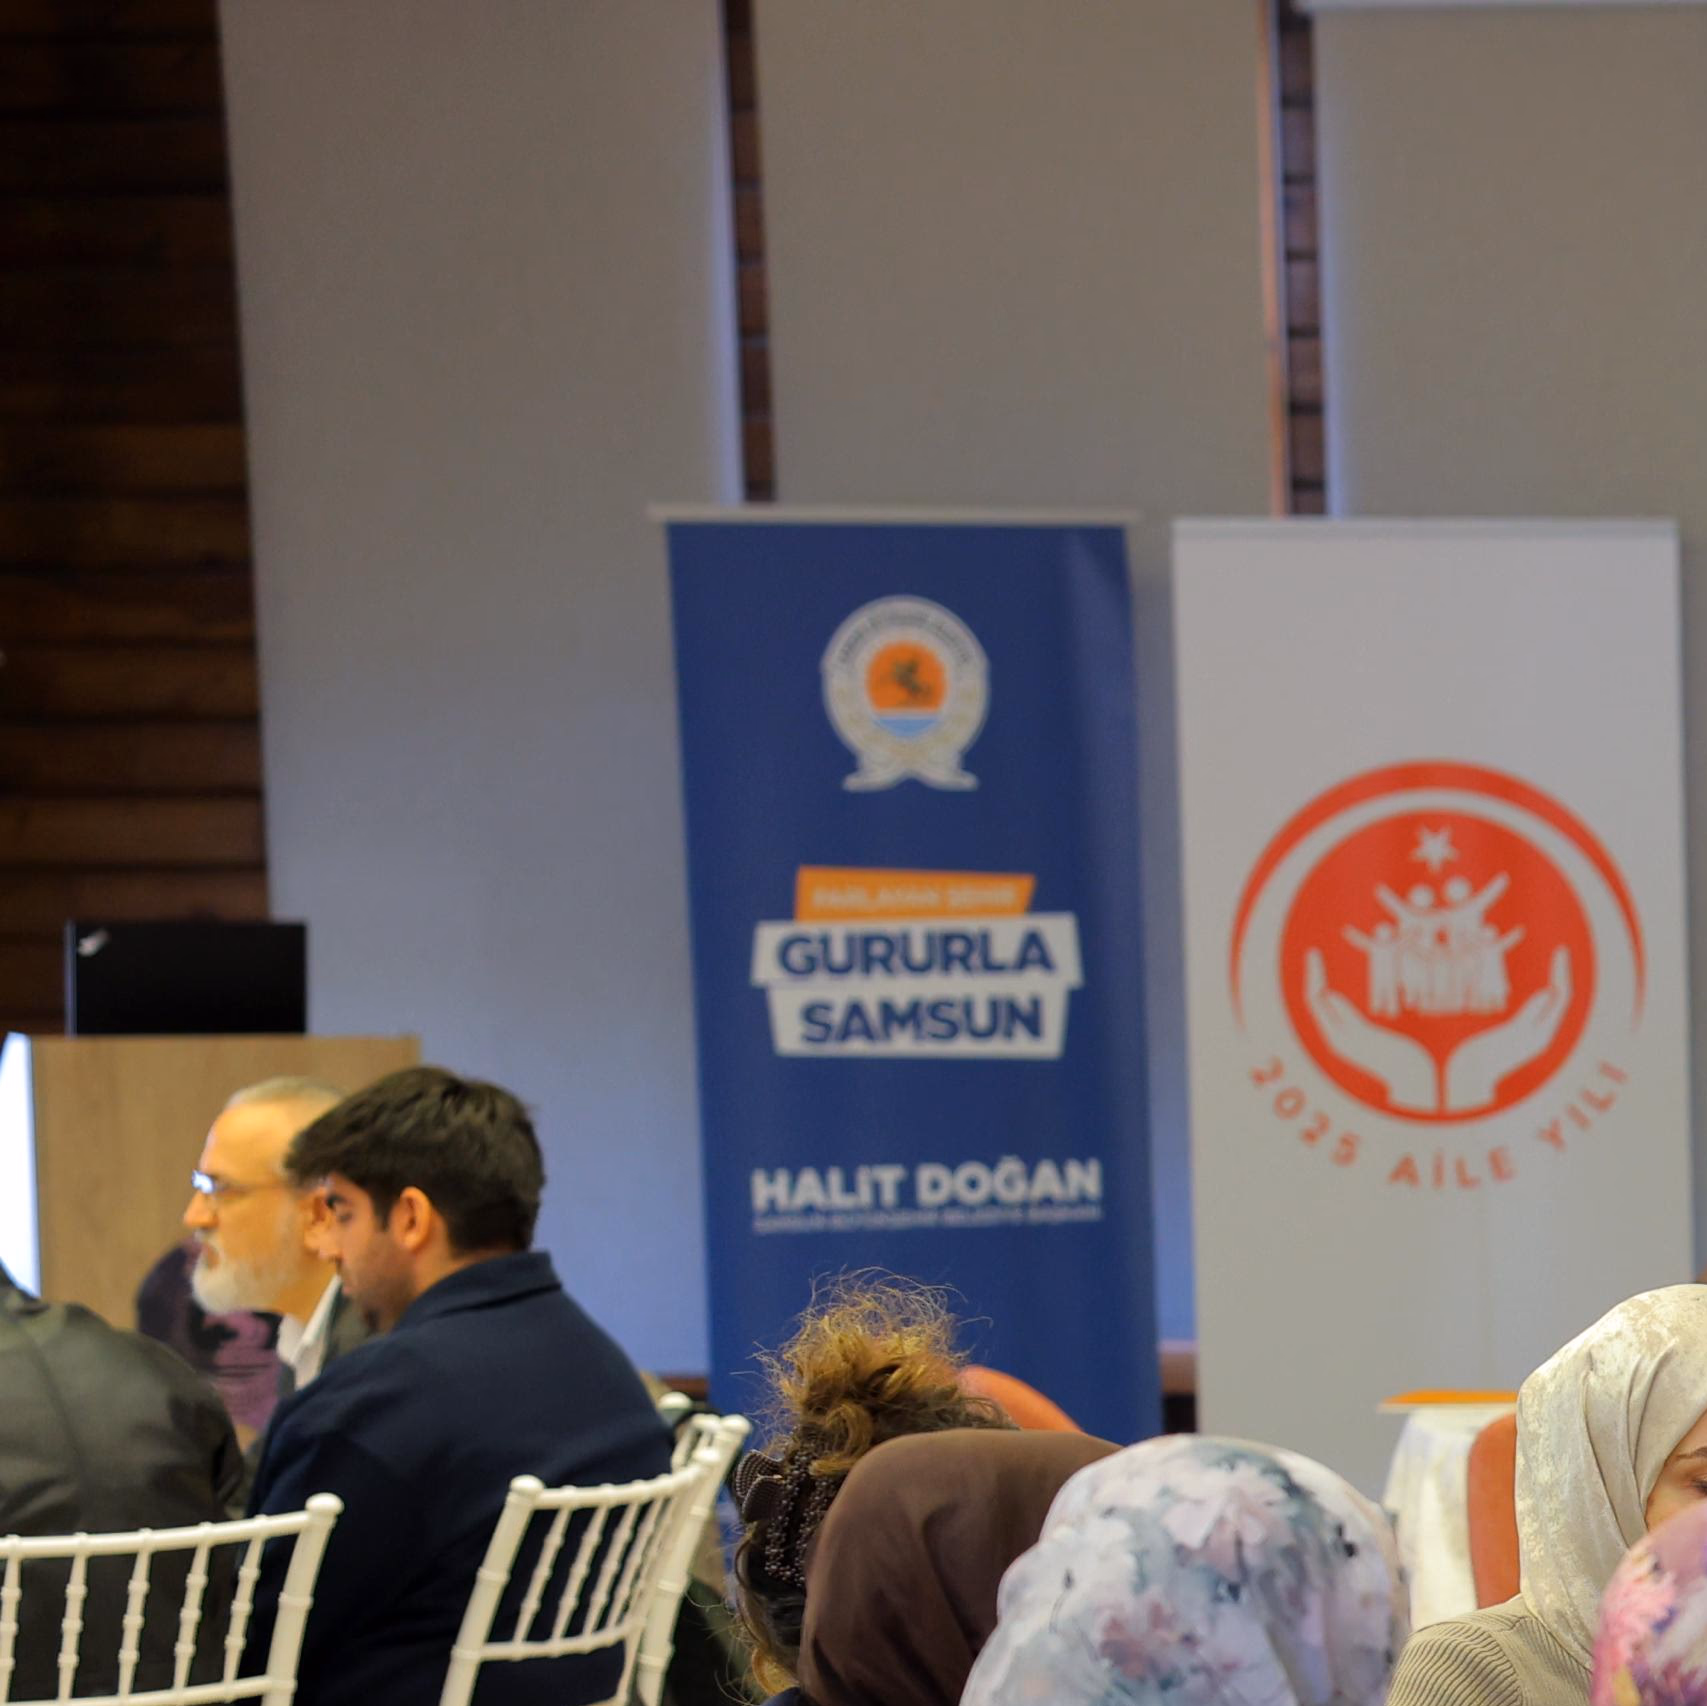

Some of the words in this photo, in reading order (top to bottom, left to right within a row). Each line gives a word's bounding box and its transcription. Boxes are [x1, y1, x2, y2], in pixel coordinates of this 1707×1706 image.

[777, 928, 1056, 976] GURURLA
[800, 994, 1042, 1044] SAMSUN
[1248, 1054, 1360, 1168] 2025
[1386, 1144, 1516, 1190] AİLE
[1537, 1058, 1631, 1154] YILI
[915, 1154, 1104, 1208] DOĞAN
